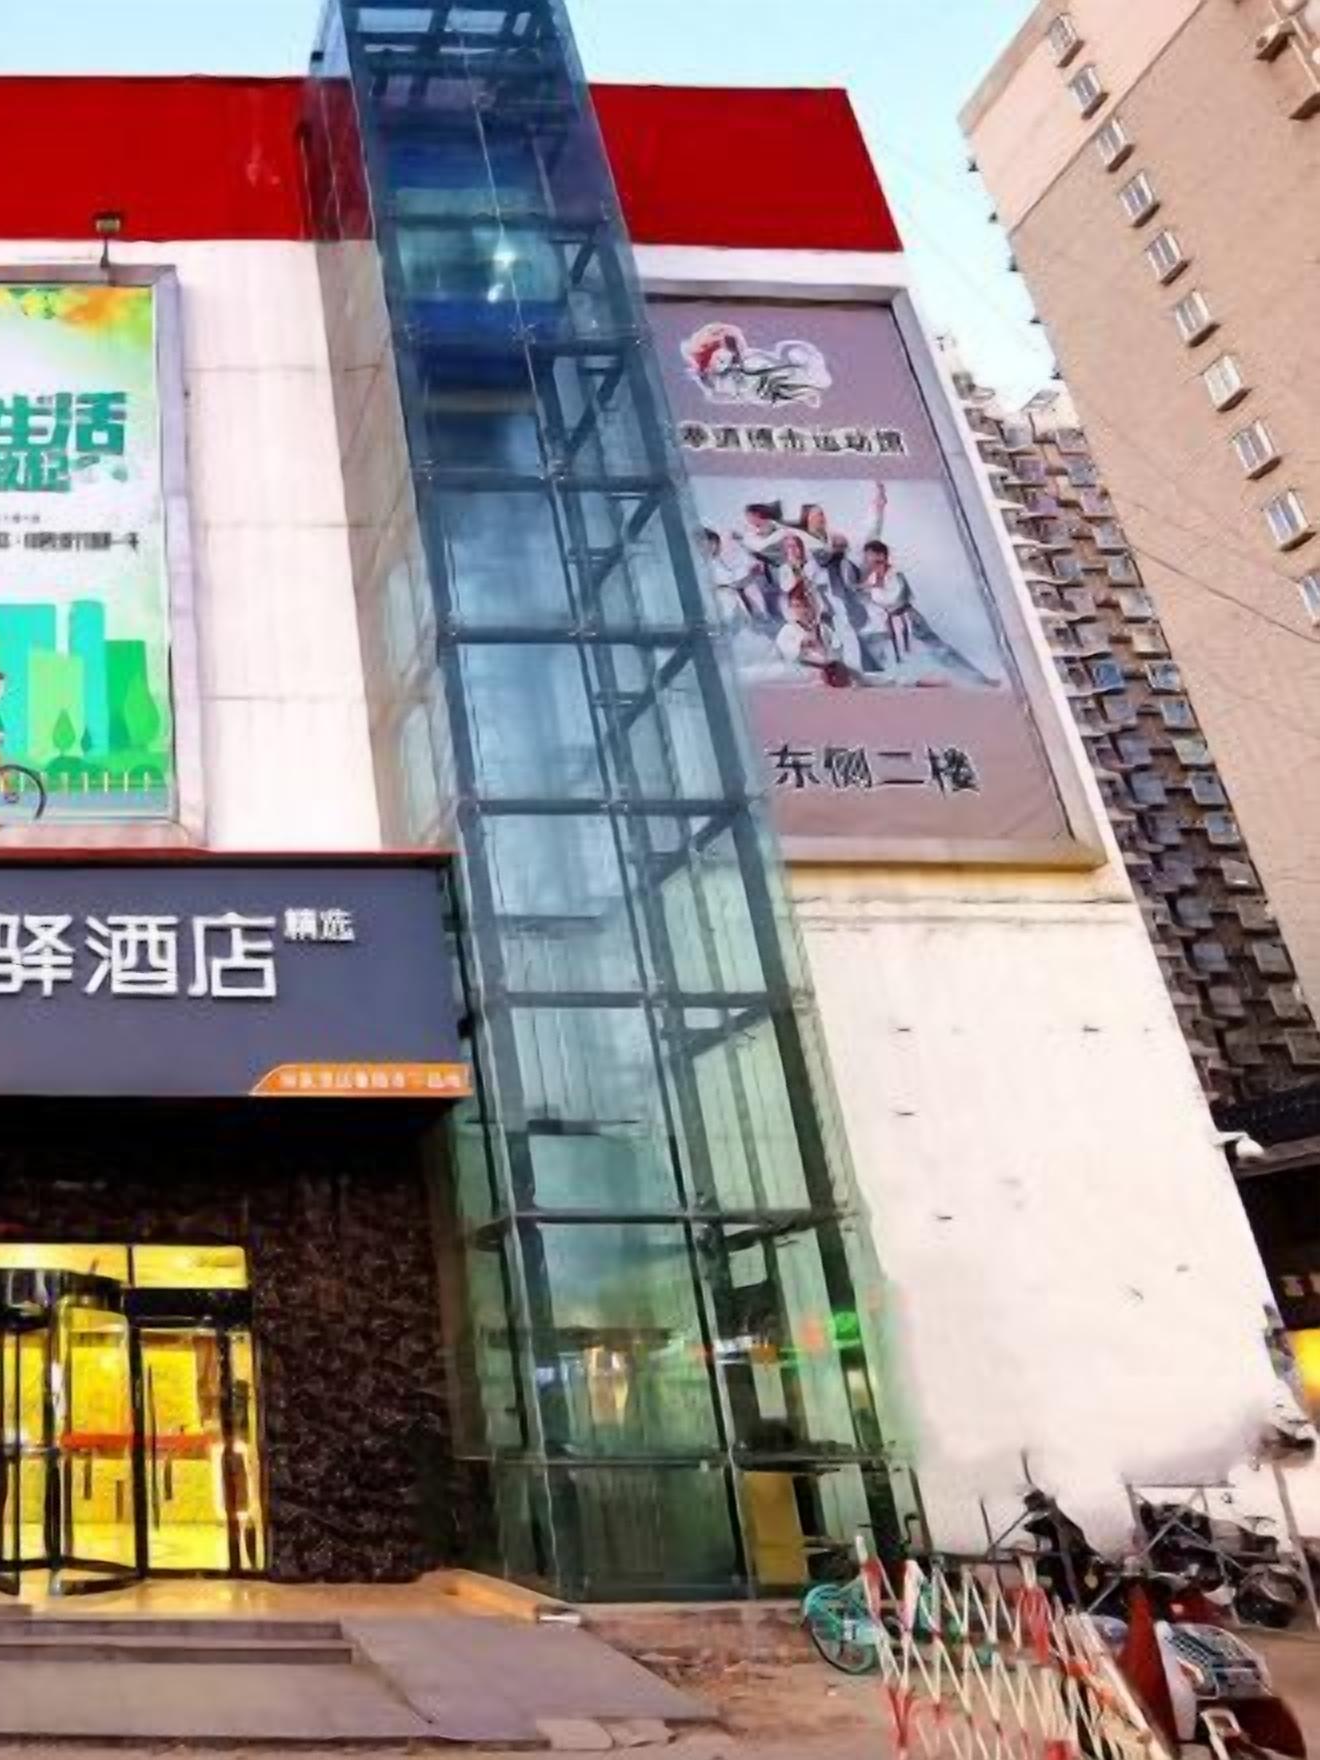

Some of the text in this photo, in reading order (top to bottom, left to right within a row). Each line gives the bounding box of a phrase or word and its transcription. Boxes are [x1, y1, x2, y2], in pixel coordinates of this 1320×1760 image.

[767, 744, 980, 798] 东侧二楼
[283, 908, 356, 941] 精选
